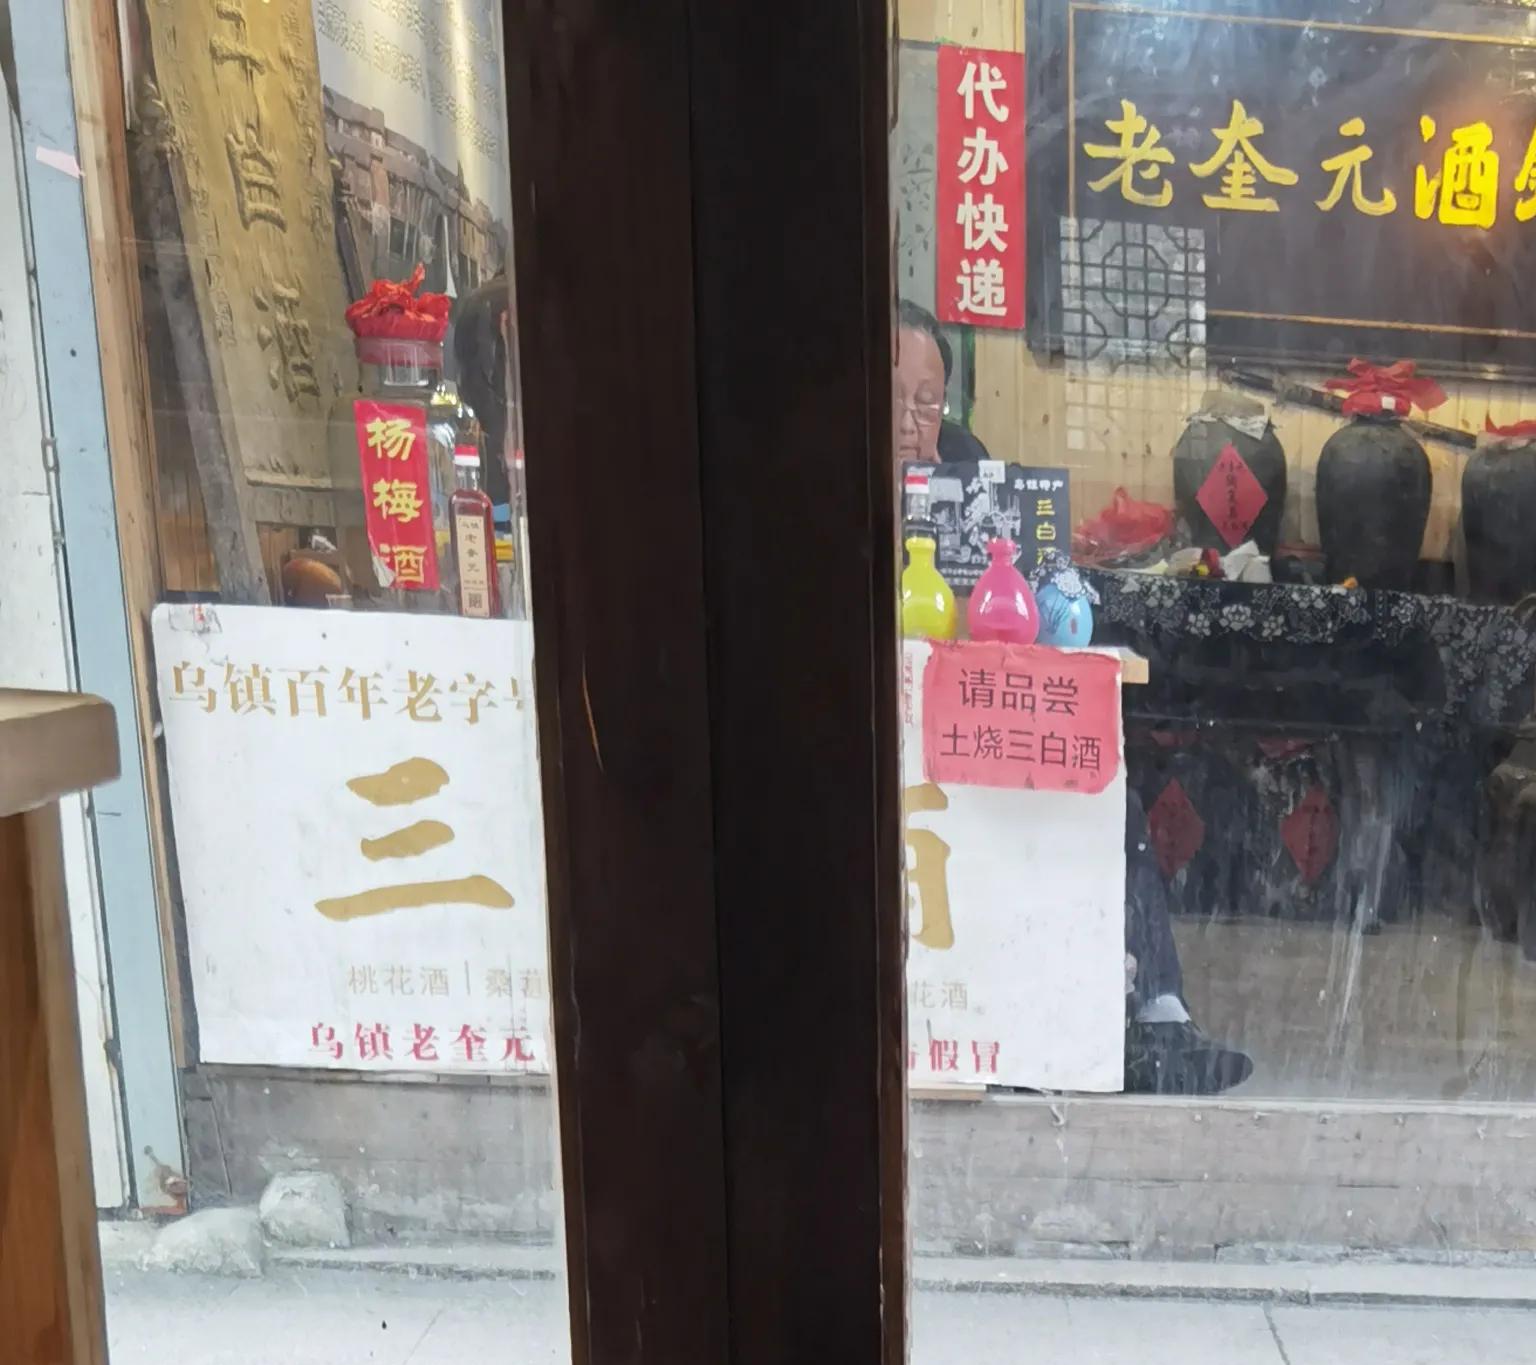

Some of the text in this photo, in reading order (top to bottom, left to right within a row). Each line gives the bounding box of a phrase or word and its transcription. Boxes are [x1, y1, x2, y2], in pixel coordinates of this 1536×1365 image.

[956, 60, 1010, 319] 代办快递
[366, 416, 427, 584] 杨梅酒
[958, 667, 1079, 716] 请品尝
[940, 722, 1104, 772] 土烧三白酒
[314, 756, 516, 922] 三
[349, 964, 449, 997] 桃花酒
[309, 1022, 537, 1063] 乌镇老奎元
